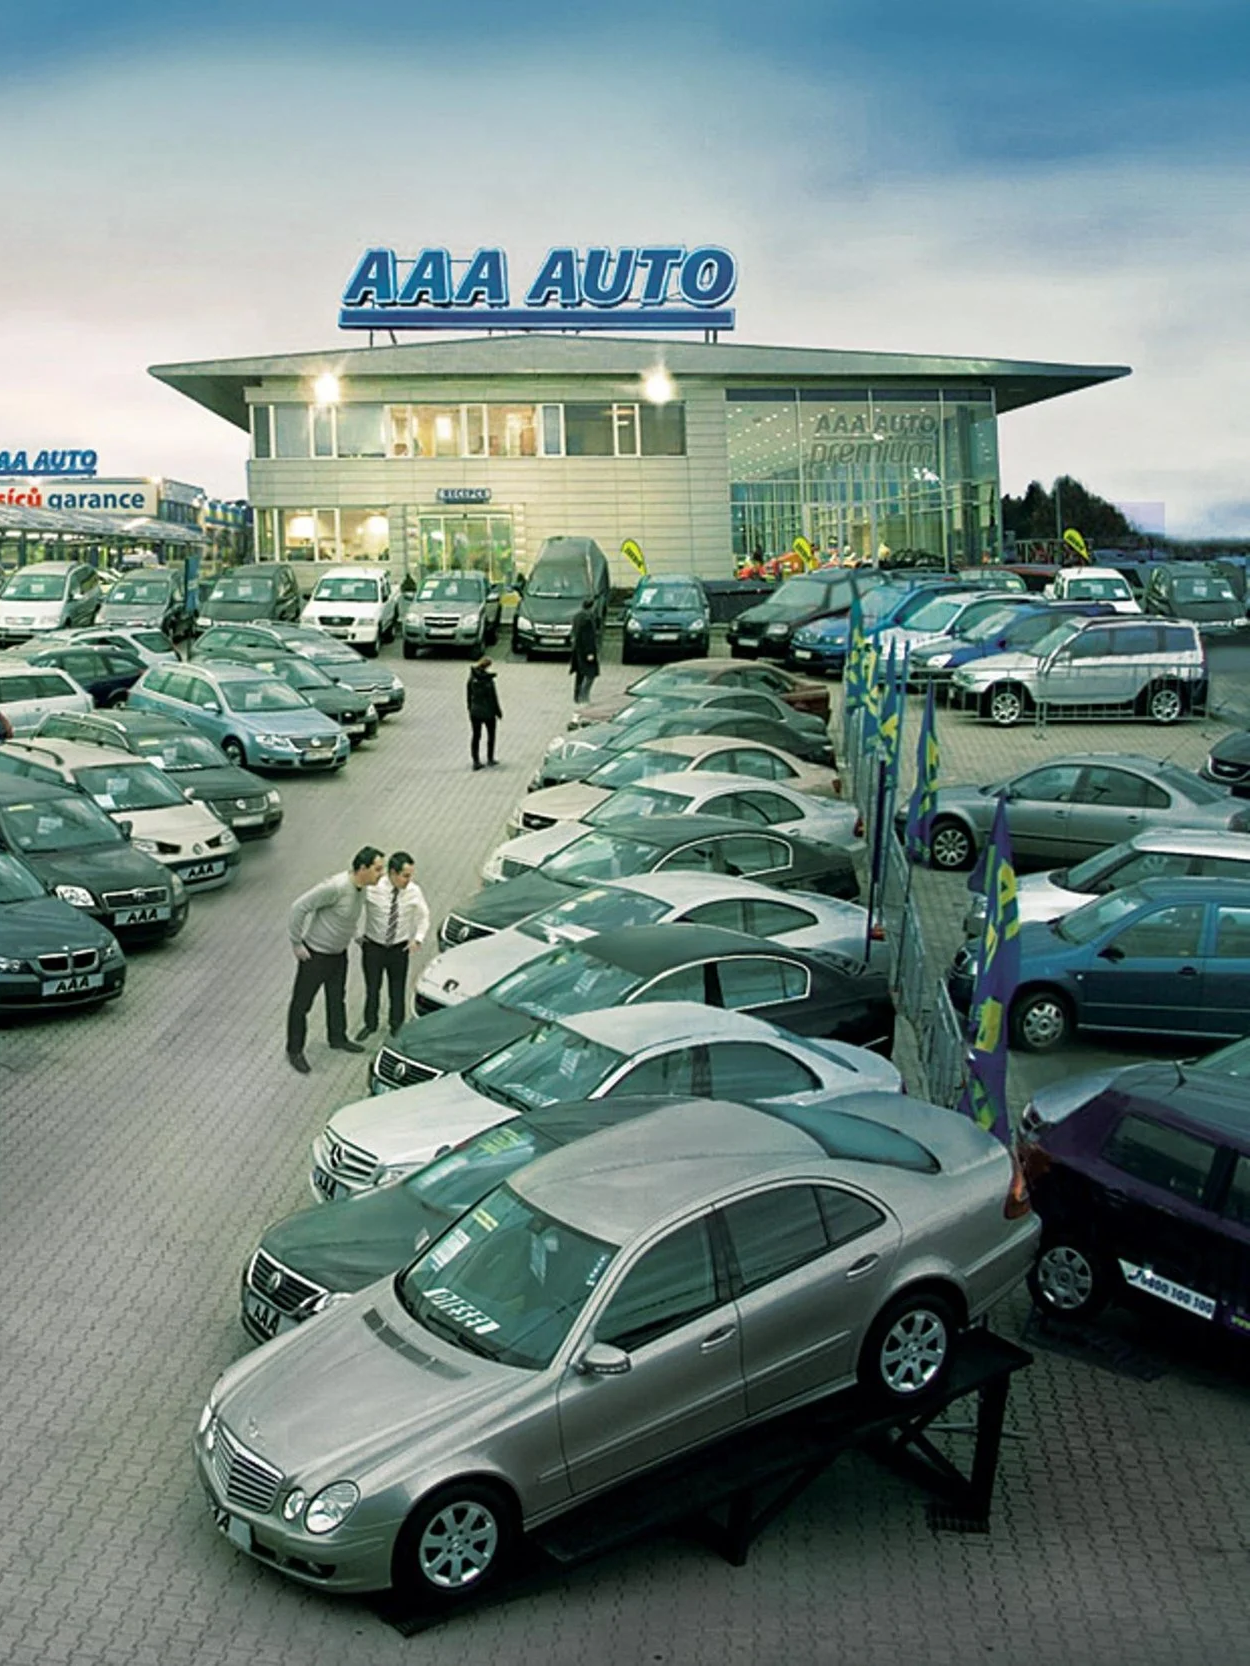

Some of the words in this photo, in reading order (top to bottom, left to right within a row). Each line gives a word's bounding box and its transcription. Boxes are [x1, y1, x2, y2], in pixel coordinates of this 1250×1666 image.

[341, 246, 510, 307] AAA
[524, 244, 738, 308] AUTO
[814, 413, 866, 433] AAA
[873, 413, 937, 434] AUTO
[33, 450, 98, 471] AUTO
[809, 441, 934, 468] premium
[47, 492, 146, 510] garance
[188, 863, 214, 878] AAA
[126, 908, 158, 923] AAA
[55, 975, 90, 993] AAA
